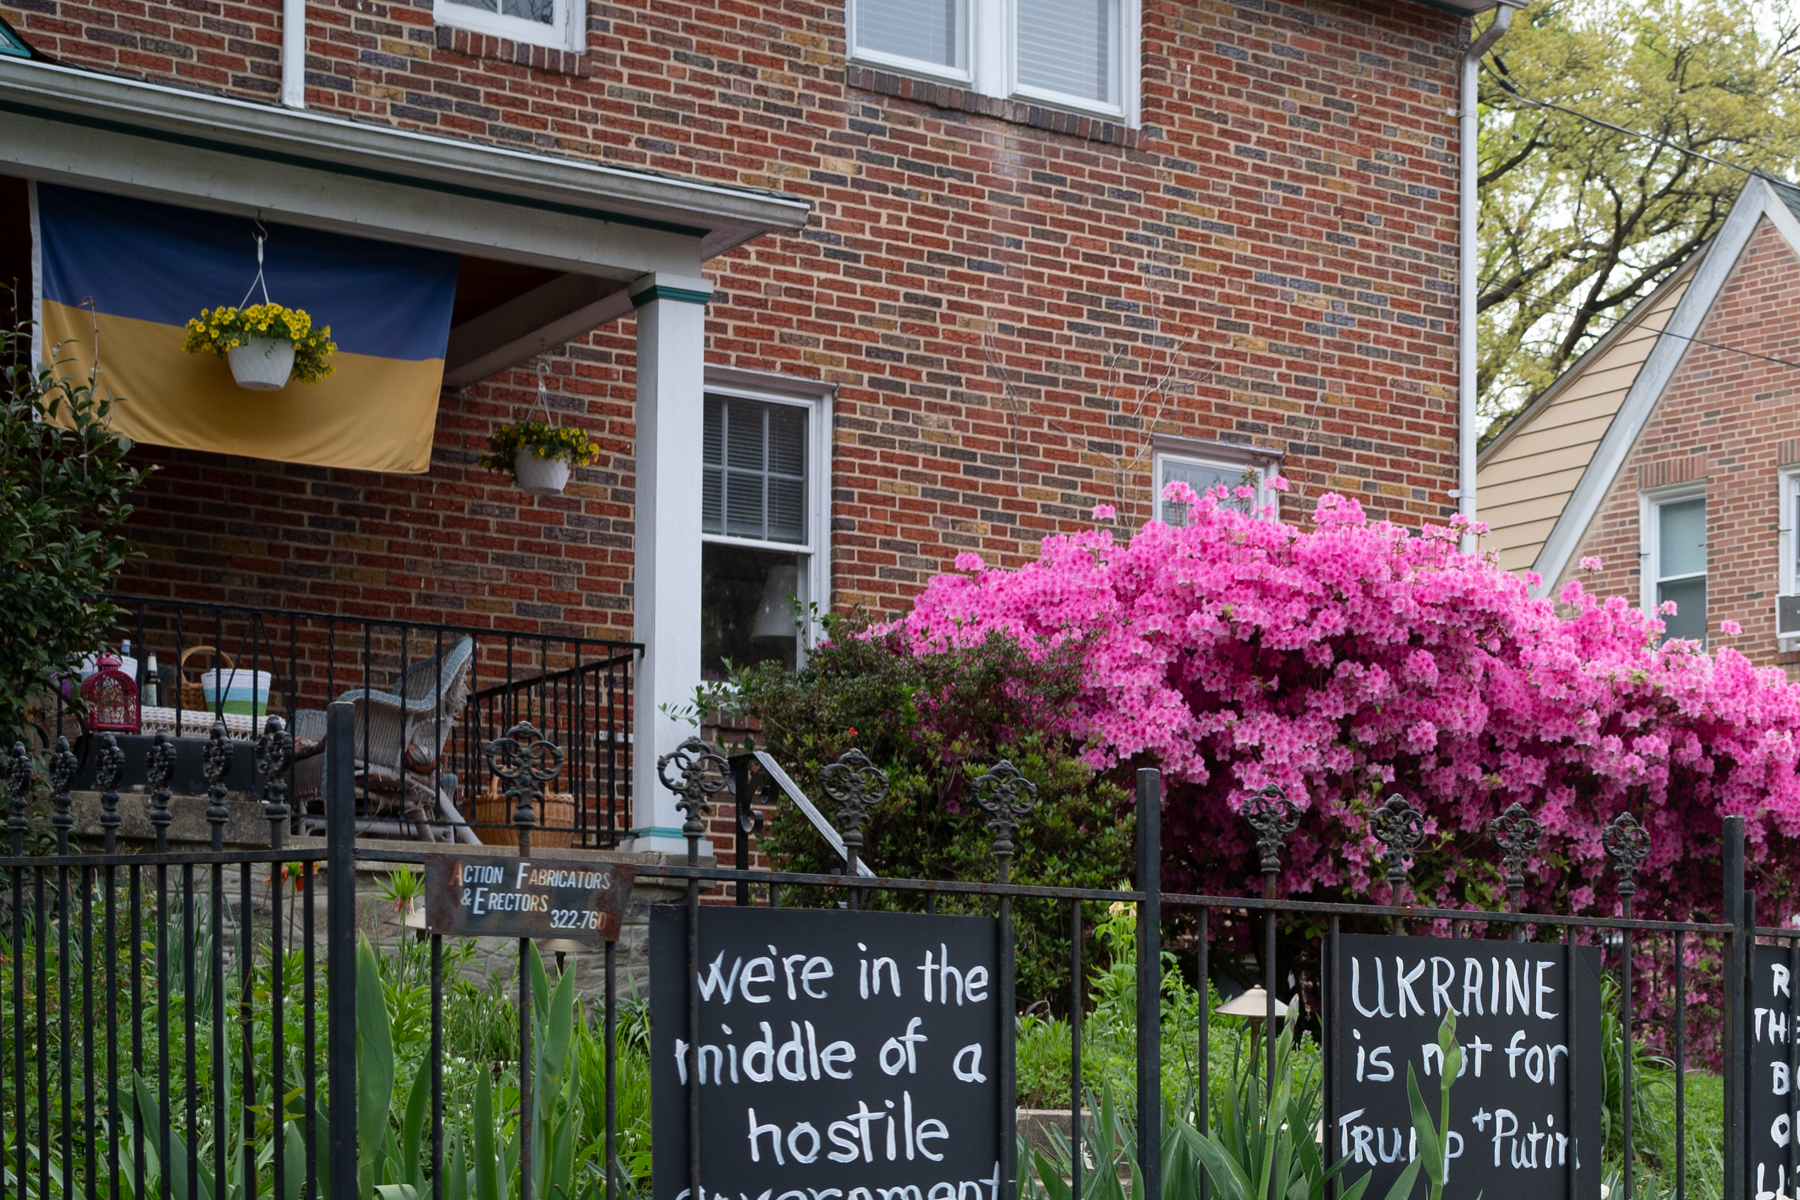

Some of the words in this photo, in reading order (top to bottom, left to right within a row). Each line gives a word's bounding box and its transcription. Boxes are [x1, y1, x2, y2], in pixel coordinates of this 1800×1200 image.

[515, 861, 611, 890] FABRICATORS
[857, 942, 901, 999] in
[917, 943, 988, 1006] the
[1351, 956, 1559, 1020] UKRAINE
[675, 1020, 856, 1085] middle
[879, 1017, 928, 1076] of
[953, 1043, 987, 1083] a
[1353, 1028, 1394, 1082] is
[1505, 1029, 1568, 1086] for
[748, 1090, 949, 1165] hostile
